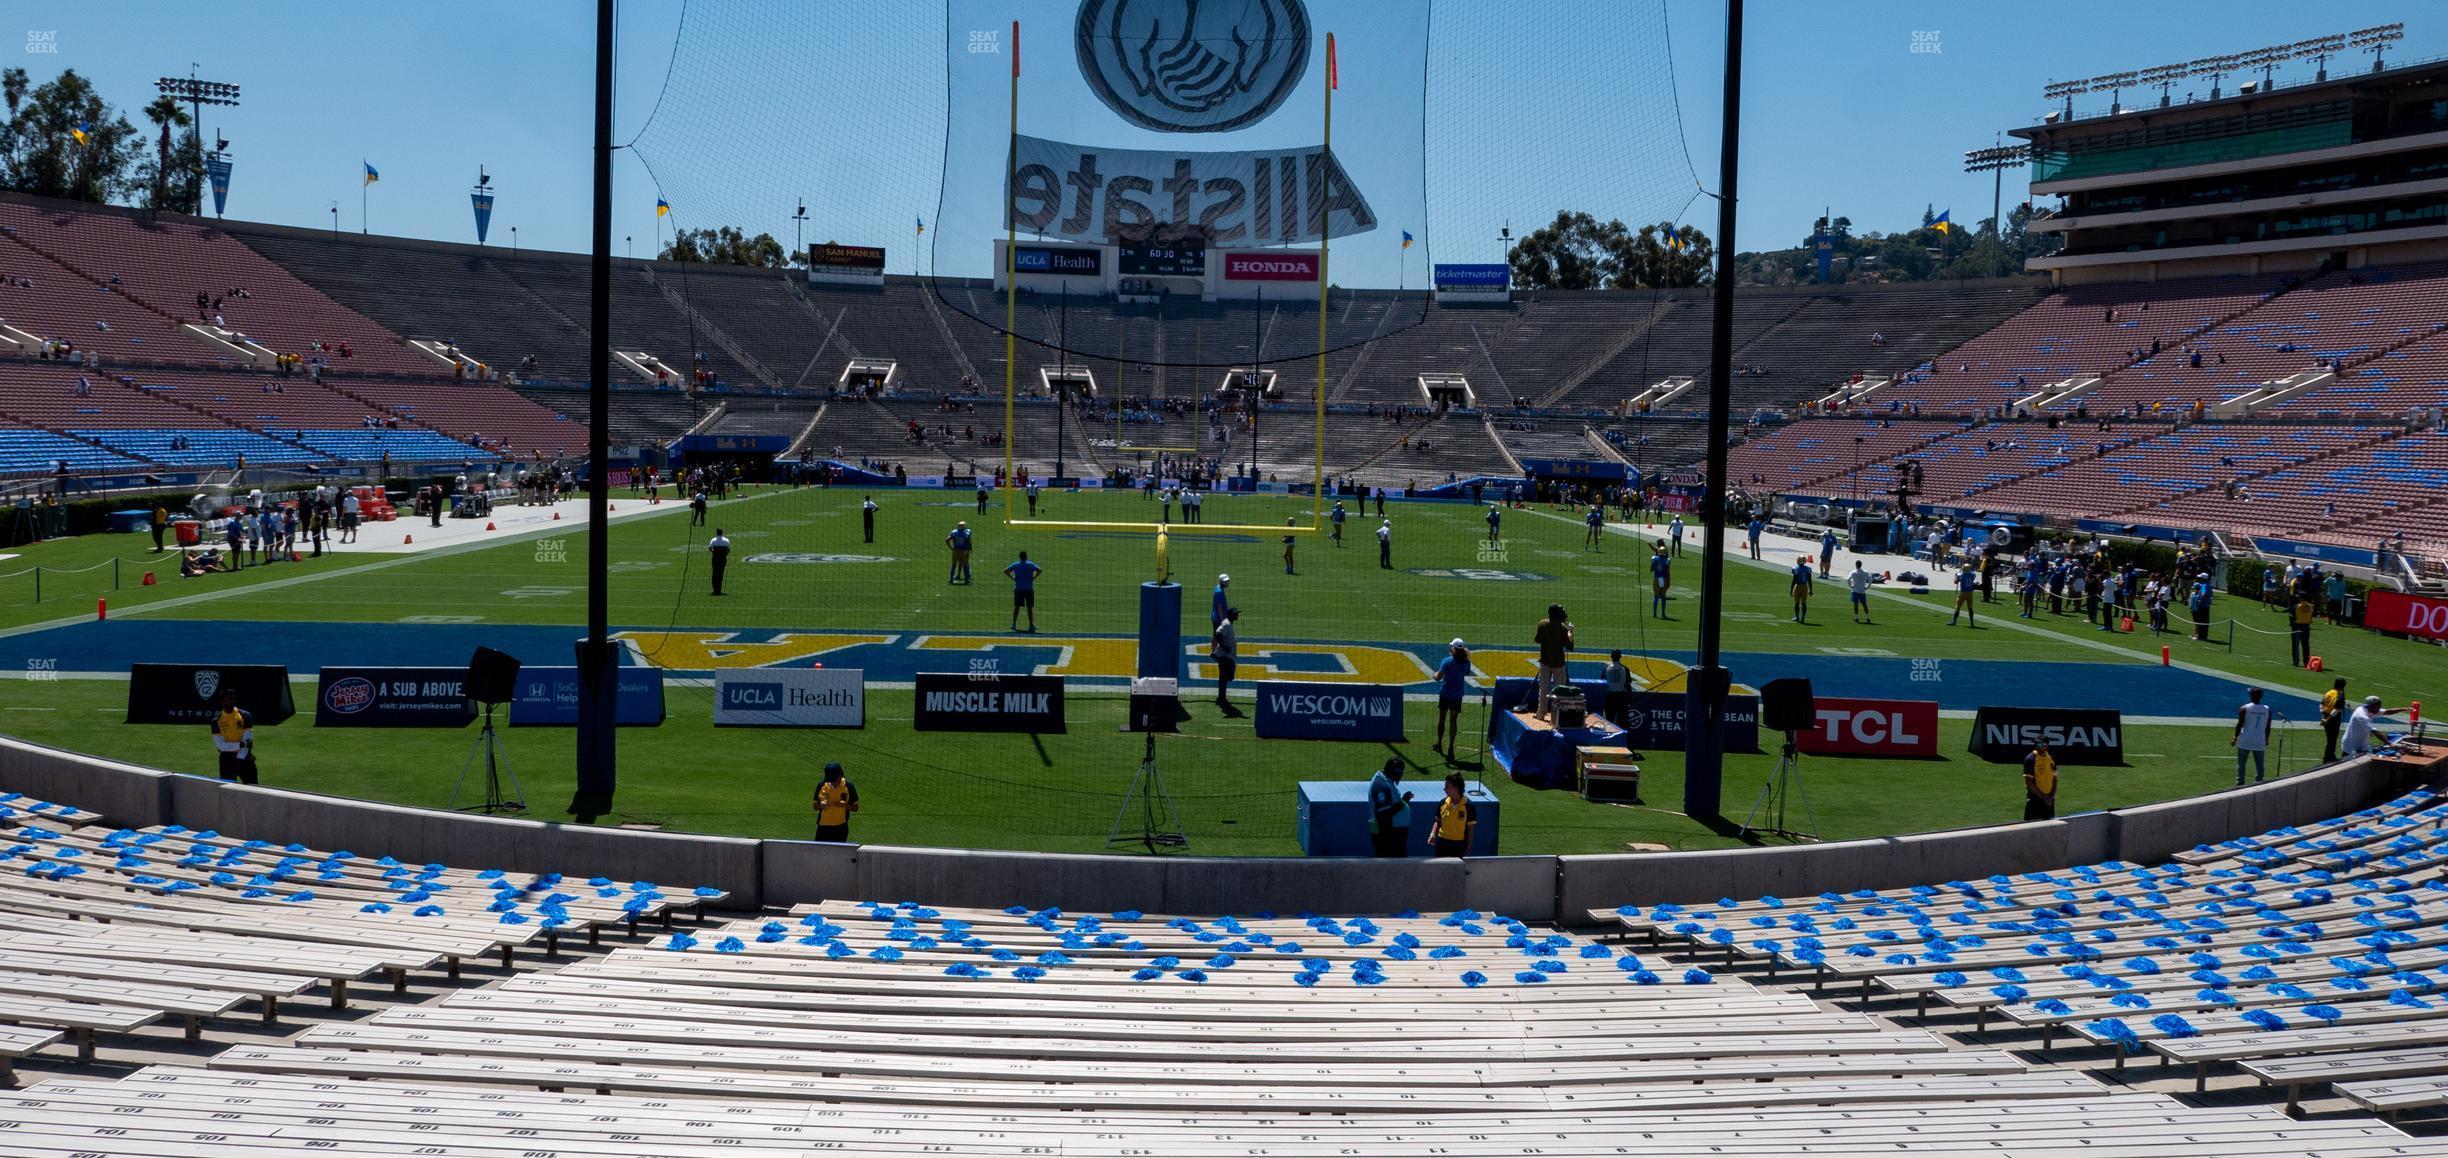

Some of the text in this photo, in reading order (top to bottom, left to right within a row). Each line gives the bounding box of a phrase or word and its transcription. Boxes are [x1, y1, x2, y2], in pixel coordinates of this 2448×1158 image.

[826, 248, 882, 258] SAN MANUEL
[1017, 254, 1095, 268] UCLA Health
[1232, 262, 1312, 273] HONDA
[1436, 269, 1503, 278] ticketmaster
[1661, 474, 1696, 484] ONDA
[380, 682, 463, 696] A SUB ABOVE
[731, 688, 856, 706] UCLA Health
[926, 692, 1048, 712] MUSCLE MILK
[399, 703, 462, 711] jerseymikes.com
[1270, 694, 1366, 716] WESCOM
[1651, 710, 1672, 719] THE
[1310, 718, 1356, 726] wescom.org
[1660, 722, 1682, 731] TEA
[1816, 710, 1918, 744] TCL
[1986, 724, 2117, 748] NISSAN
